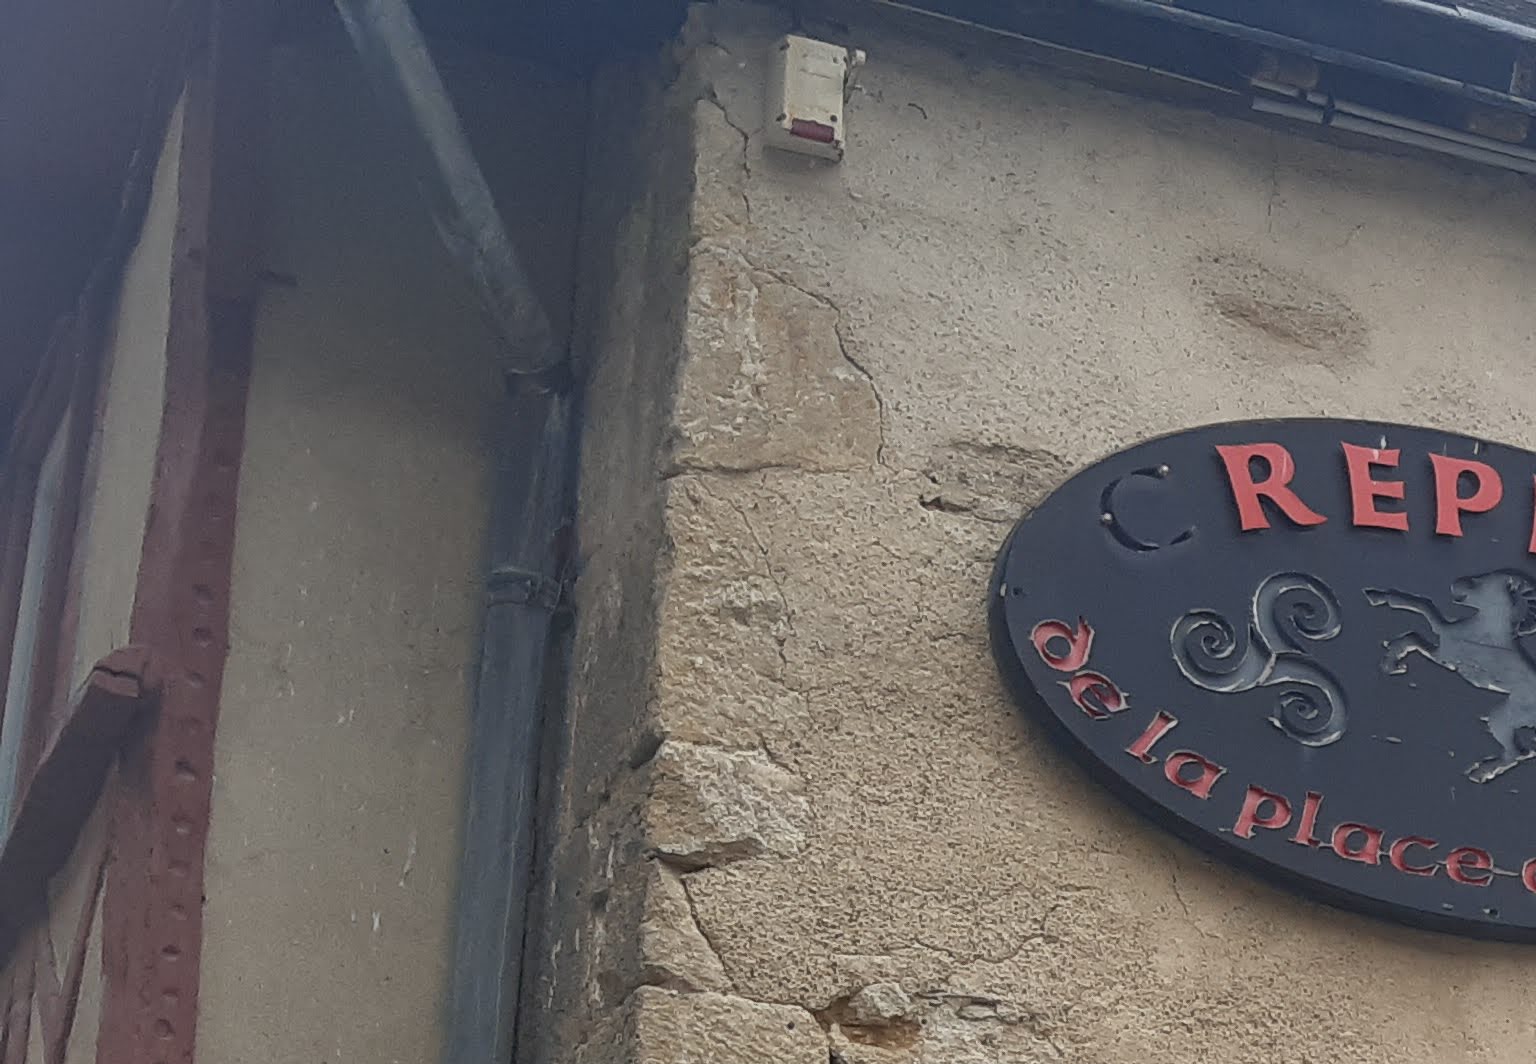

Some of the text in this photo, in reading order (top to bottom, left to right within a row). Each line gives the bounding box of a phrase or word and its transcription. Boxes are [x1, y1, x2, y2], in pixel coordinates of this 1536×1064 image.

[1030, 616, 1131, 720] de
[1123, 711, 1227, 800] la
[1232, 784, 1494, 886] place
